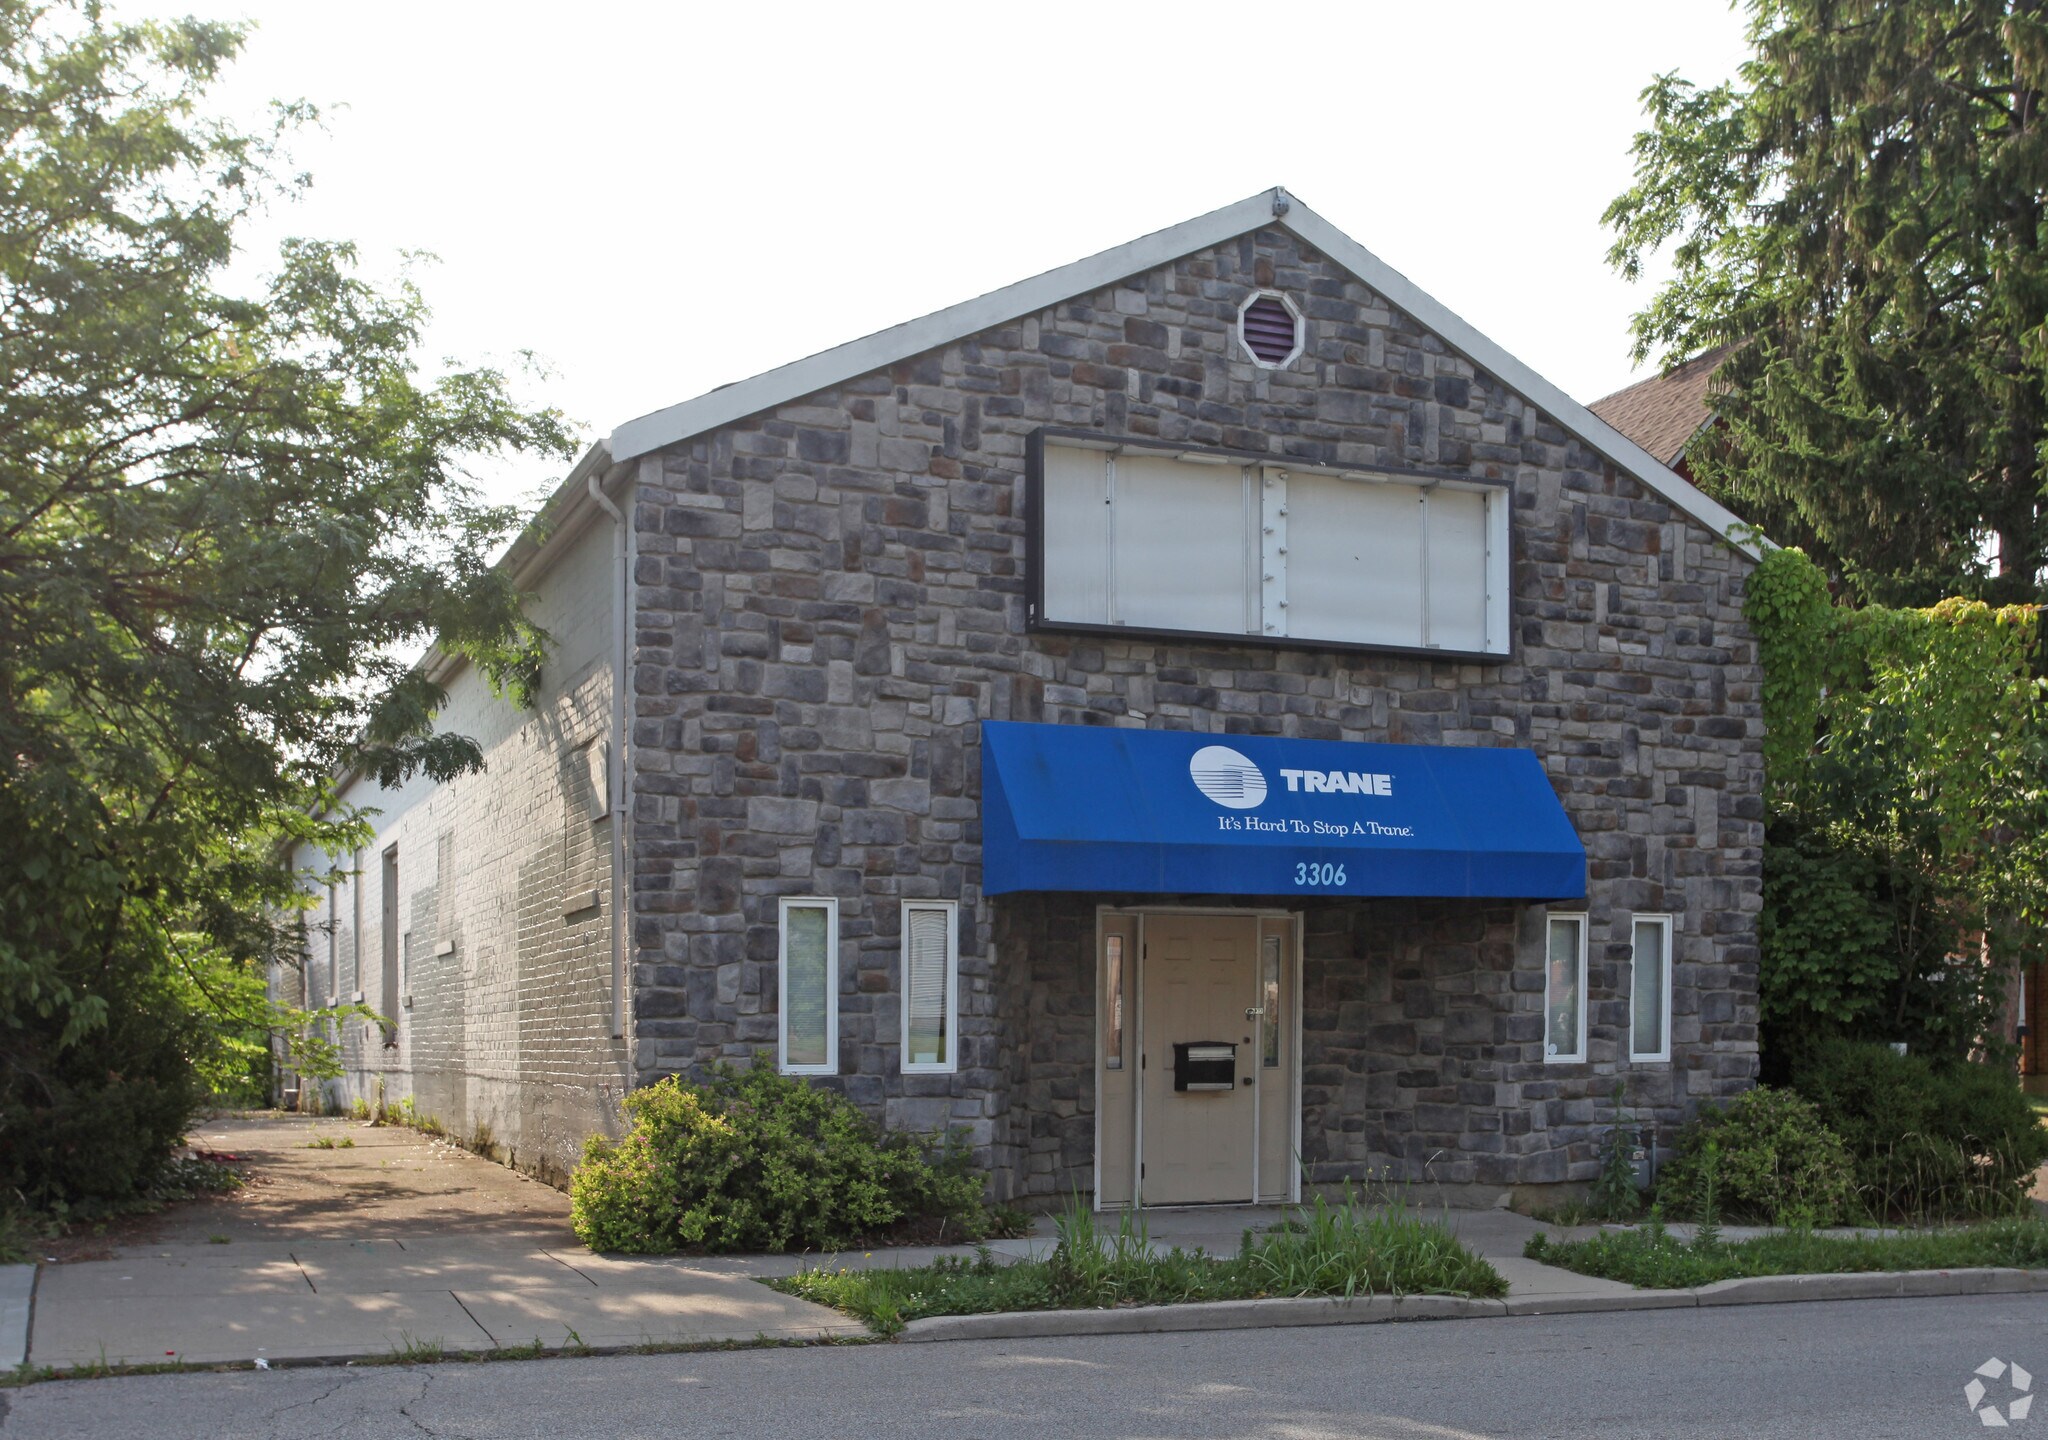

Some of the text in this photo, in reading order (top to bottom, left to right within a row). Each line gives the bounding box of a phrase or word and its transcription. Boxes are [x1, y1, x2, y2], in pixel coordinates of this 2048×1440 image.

[1279, 768, 1393, 796] TRANE
[1218, 816, 1242, 831] It's
[1244, 817, 1288, 833] Hard
[1289, 819, 1310, 834] To
[1313, 820, 1349, 838] Stop
[1351, 821, 1365, 835] A
[1294, 862, 1347, 886] 3306
